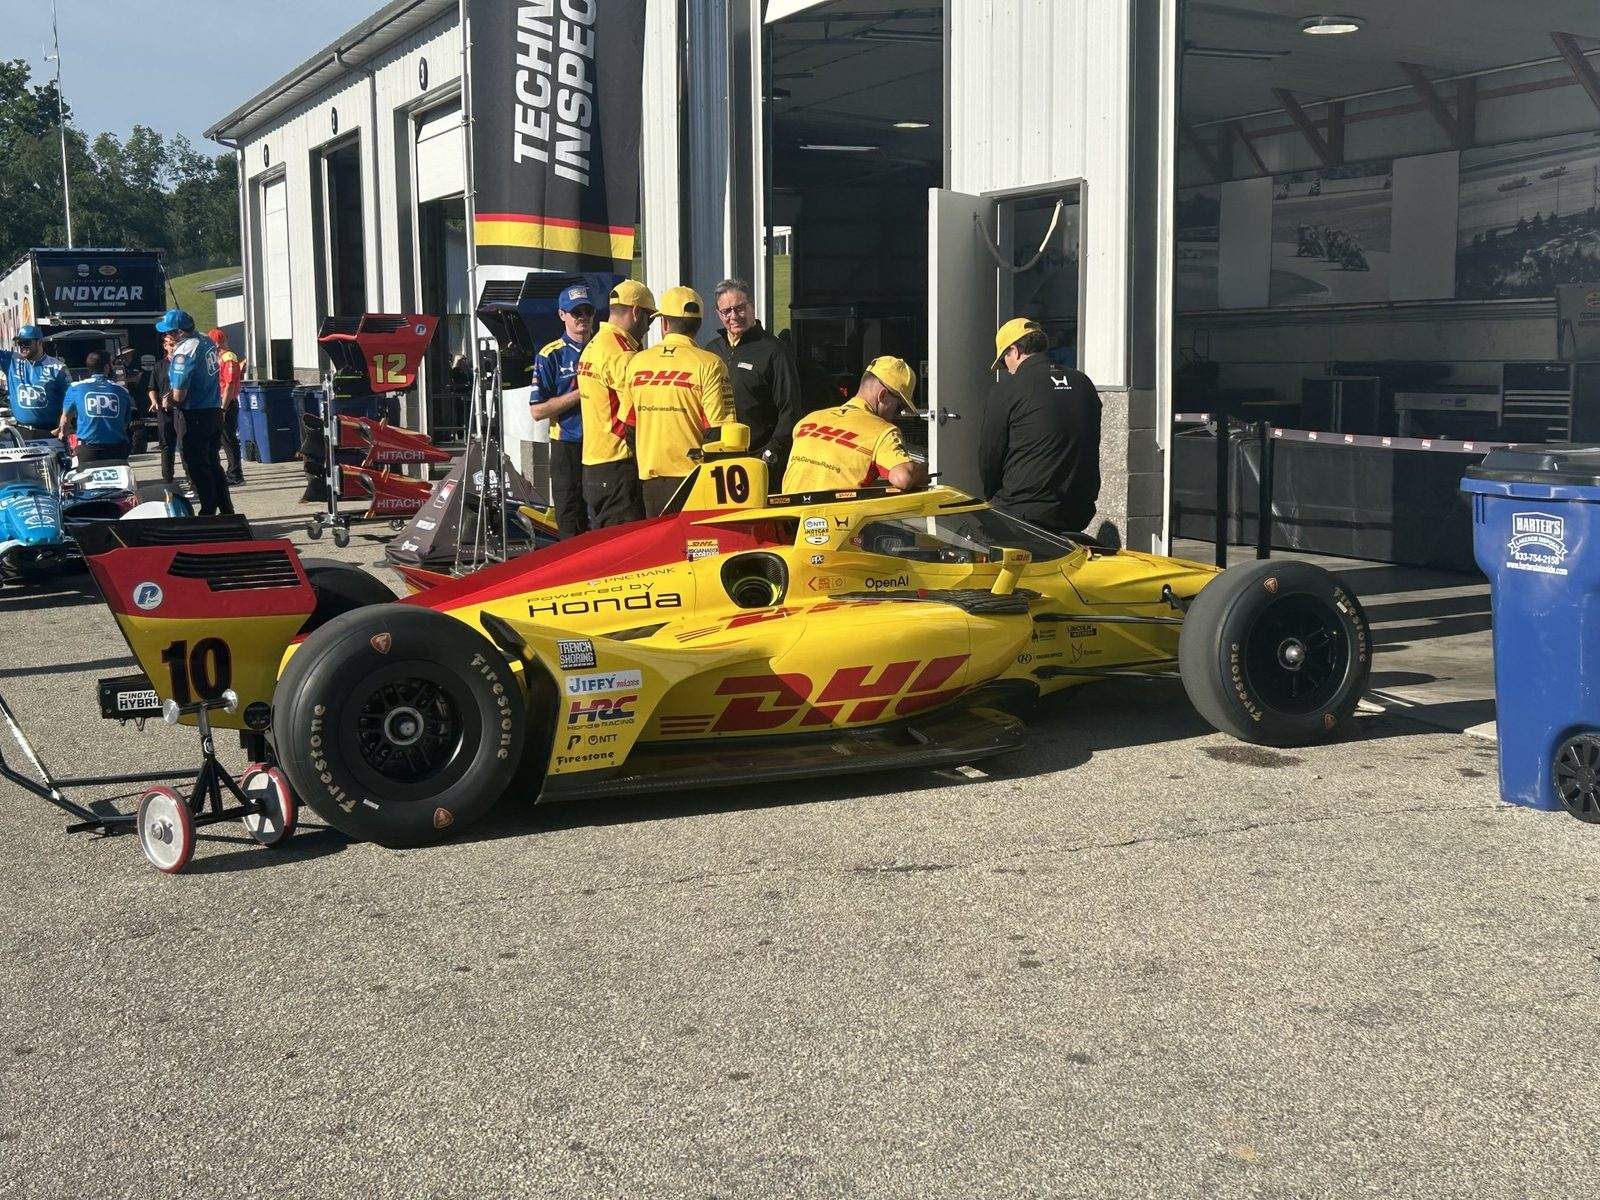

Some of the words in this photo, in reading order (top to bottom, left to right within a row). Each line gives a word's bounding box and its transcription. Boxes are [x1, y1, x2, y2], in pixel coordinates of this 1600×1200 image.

[54, 286, 143, 300] INDYCAR
[372, 353, 407, 384] 12
[633, 370, 696, 389] DHL
[87, 395, 118, 415] PPG
[796, 422, 859, 450] DHL
[377, 450, 426, 460] HITACHI
[93, 469, 120, 481] PPG
[710, 464, 750, 505] 10
[637, 566, 676, 580] BANK
[865, 575, 909, 591] OpenAI
[527, 584, 623, 604] Powered
[629, 582, 655, 591] by
[528, 591, 682, 618] Honda
[559, 641, 593, 654] TRENCH
[560, 652, 594, 665] SHORING
[161, 637, 232, 704] 10
[569, 676, 616, 693] JIFFY
[616, 679, 640, 689] mixes
[709, 653, 974, 733] DHL
[469, 652, 513, 761] Firestone
[568, 695, 638, 725] HRC
[601, 718, 635, 728] RACING
[599, 733, 618, 744] NTT
[310, 703, 357, 814] Firestone
[556, 751, 615, 766] Firestone
